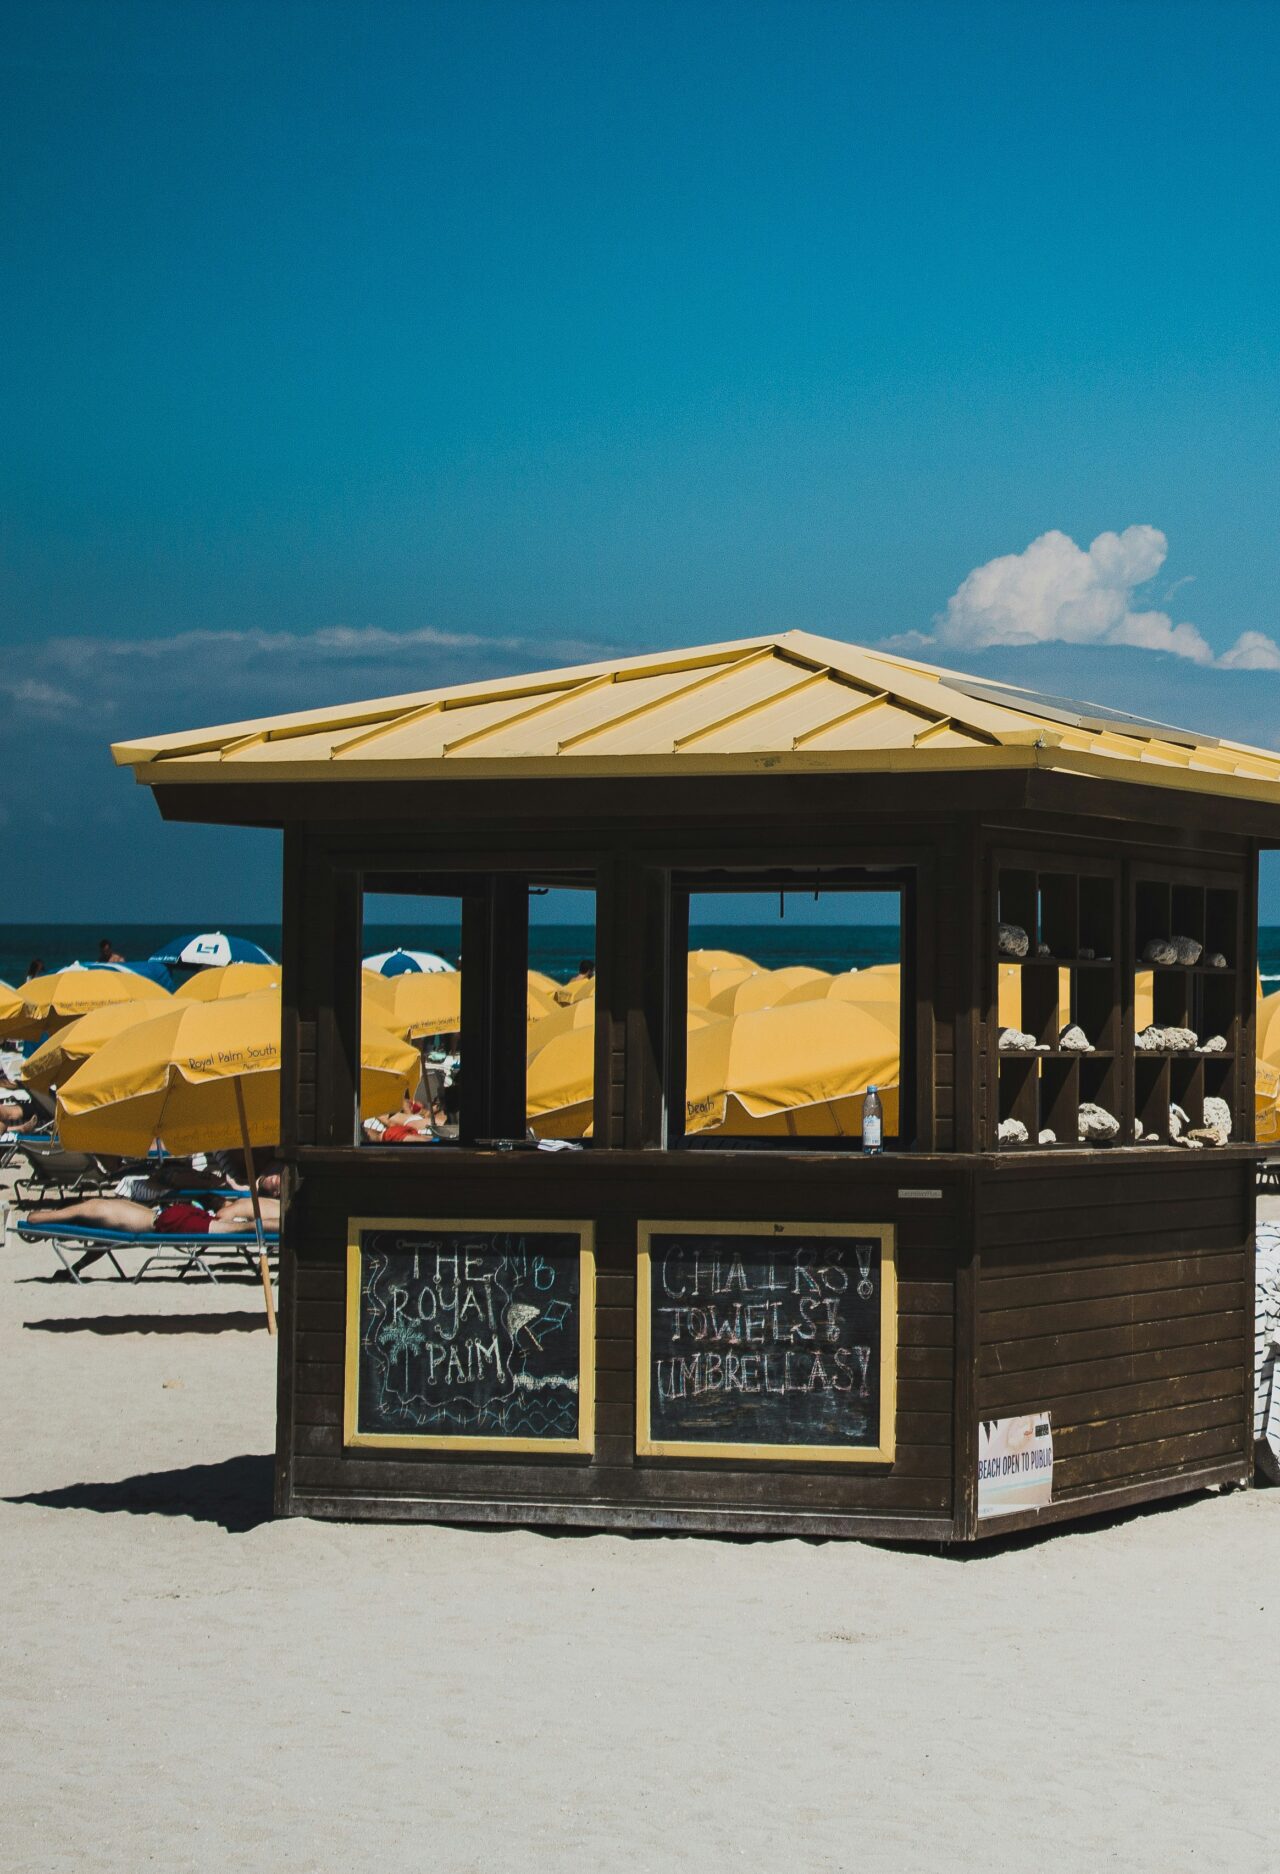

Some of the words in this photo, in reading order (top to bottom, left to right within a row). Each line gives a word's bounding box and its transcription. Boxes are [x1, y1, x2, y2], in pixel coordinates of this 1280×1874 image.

[189, 1054, 214, 1072] Royal
[218, 1050, 243, 1062] Palm
[247, 1043, 277, 1058] South
[687, 1096, 714, 1115] Beach
[396, 1240, 488, 1284] THE
[978, 1458, 1001, 1480] BEACH
[1003, 1454, 1020, 1476] OPEN
[1021, 1452, 1029, 1472] TO
[1031, 1448, 1053, 1470] PUBLIC
